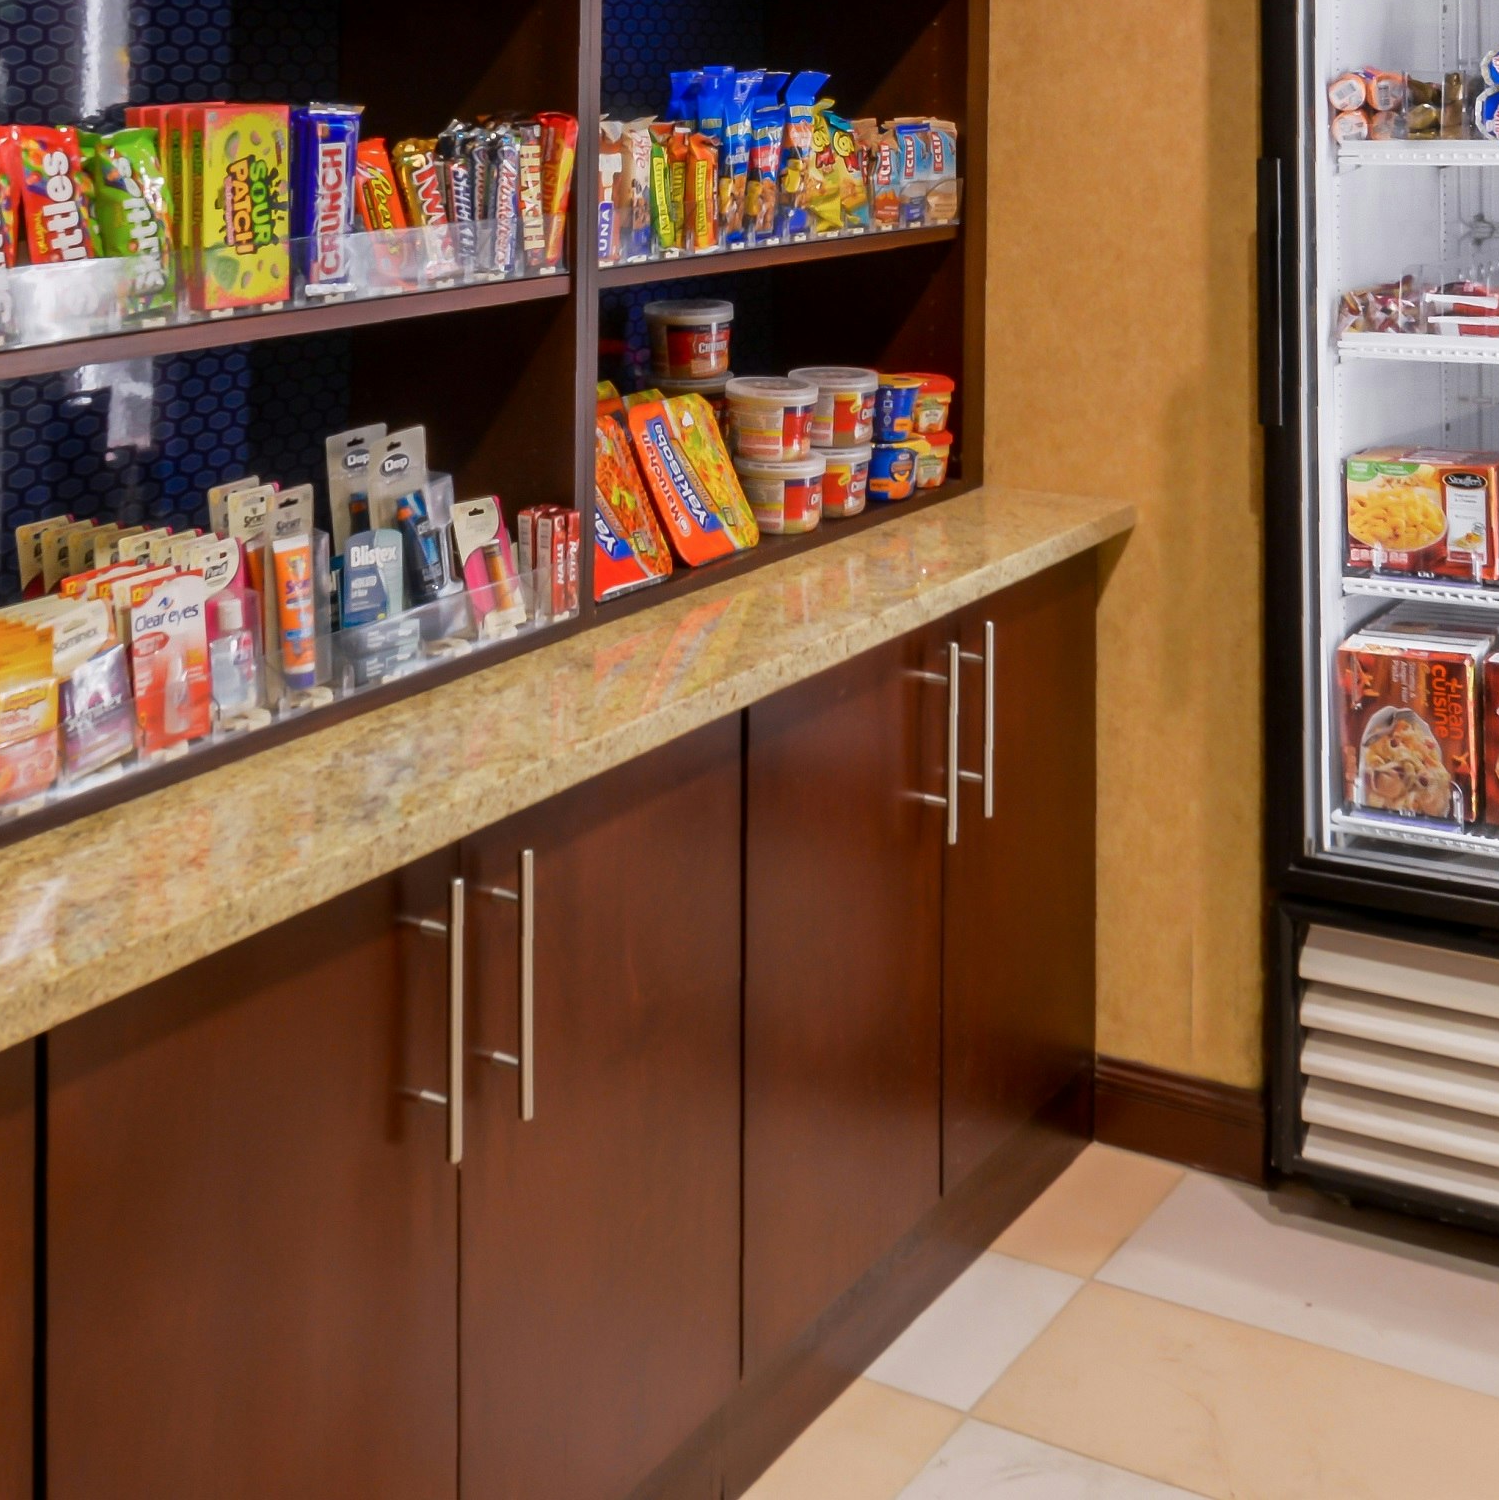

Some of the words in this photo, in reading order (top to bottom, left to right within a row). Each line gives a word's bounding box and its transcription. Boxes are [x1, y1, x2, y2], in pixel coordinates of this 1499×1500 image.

[226, 155, 256, 255] PATCH
[249, 160, 272, 243] SOUR
[319, 146, 343, 277] CRUNCH
[385, 457, 408, 472] Dep
[642, 432, 680, 522] Maruchan
[654, 422, 710, 529] Yakisoba
[350, 545, 397, 568] Blistex
[135, 612, 165, 633] Clear
[168, 604, 199, 625] eyes
